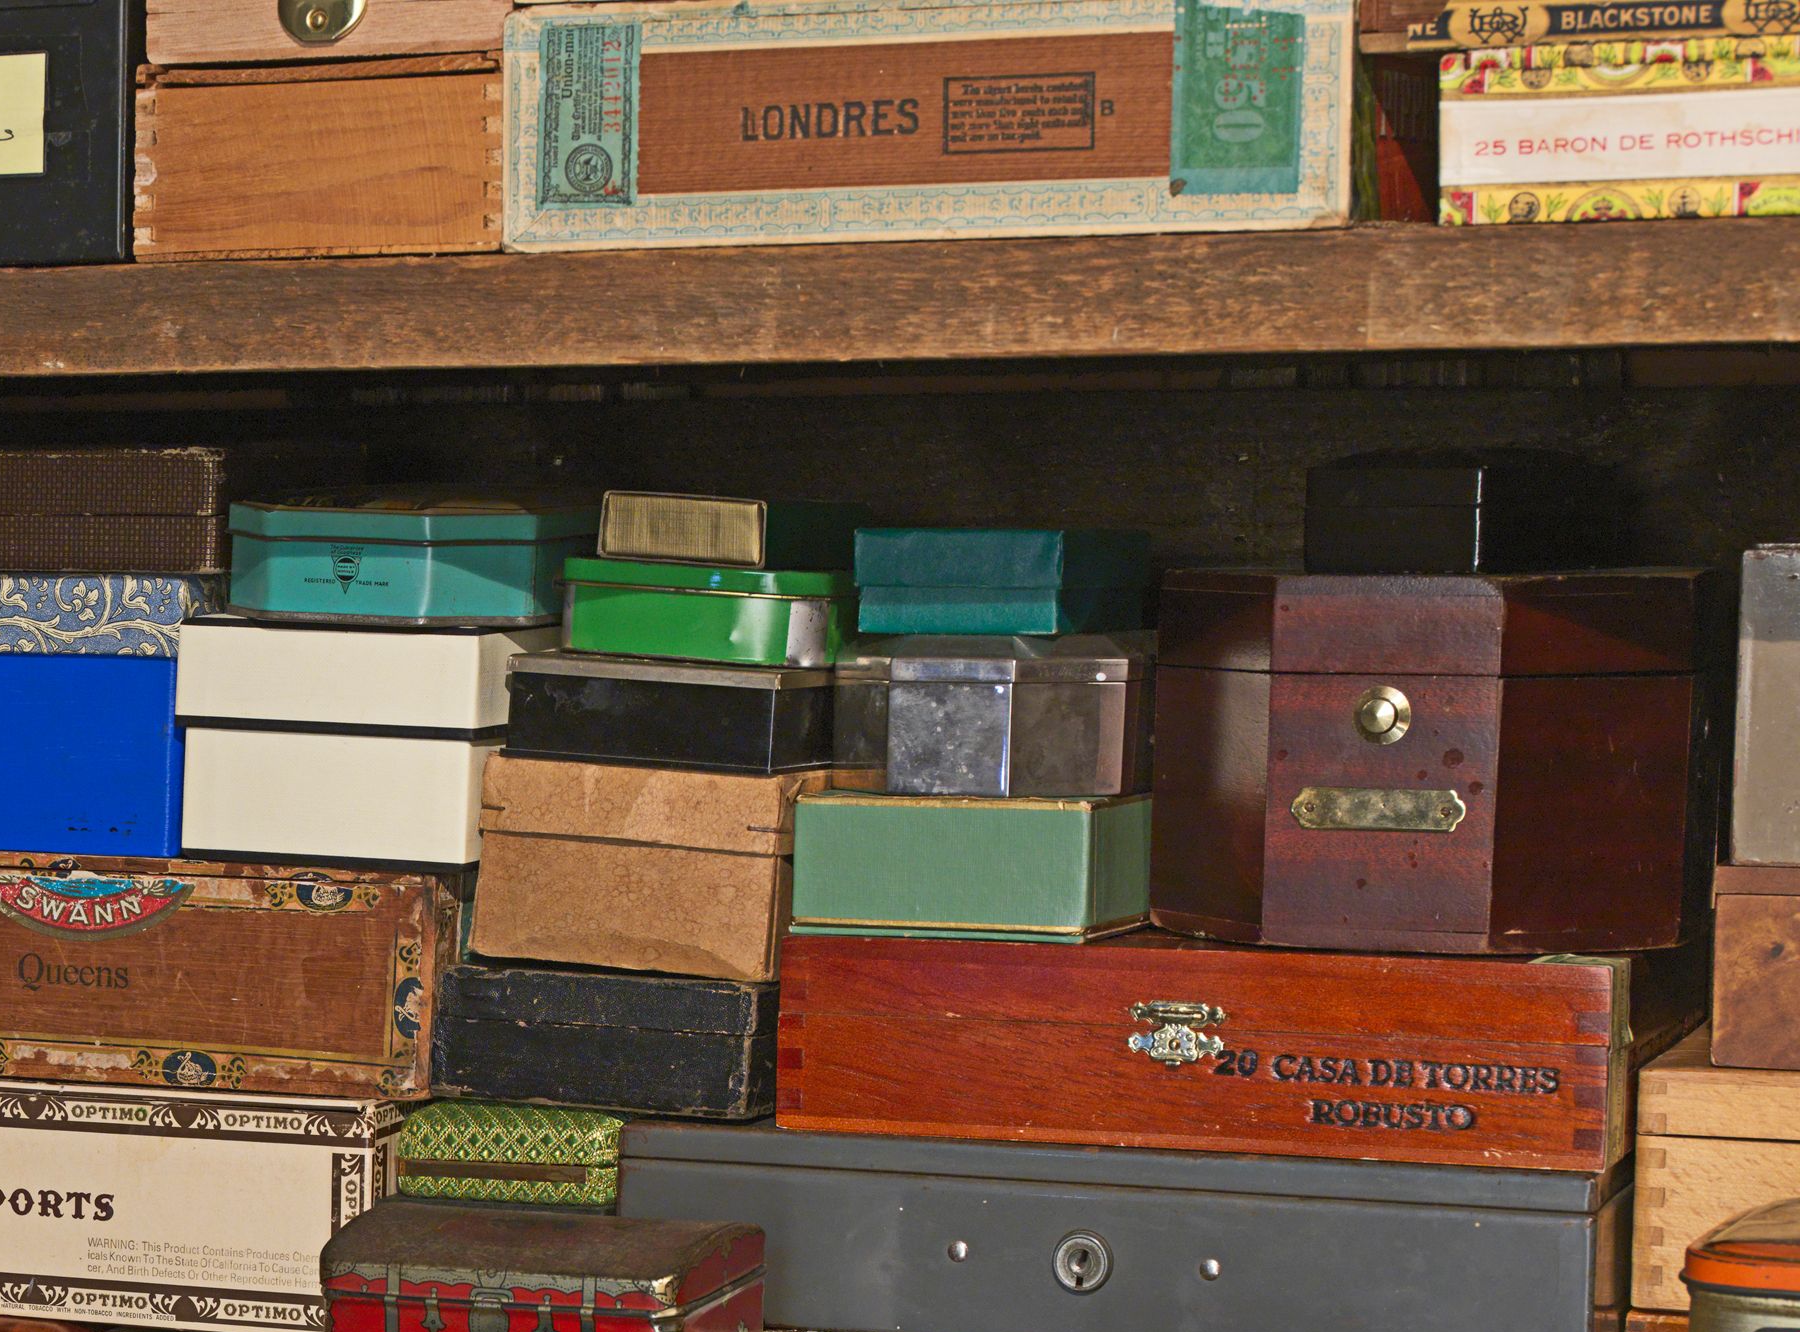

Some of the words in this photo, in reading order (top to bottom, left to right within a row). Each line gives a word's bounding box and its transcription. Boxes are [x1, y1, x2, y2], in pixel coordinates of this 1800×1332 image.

[1559, 3, 1714, 31] BLACKSTONE
[741, 98, 921, 142] LONDRES
[1101, 99, 1114, 116] B
[1474, 139, 1507, 157] 25
[1518, 136, 1608, 156] BARON
[1620, 133, 1655, 152] DE
[14, 884, 145, 926] SWANN
[17, 952, 130, 990] Queens
[1214, 1049, 1258, 1077] 20
[1272, 1053, 1361, 1086] CASA
[1369, 1059, 1416, 1088] DE
[1424, 1060, 1561, 1096] TORRES
[70, 1103, 148, 1123] OPTIMO
[223, 1112, 303, 1132] OPTIMO
[1311, 1100, 1476, 1131] ROBUSTO
[88, 1237, 139, 1251] WARNING:
[142, 1240, 160, 1252] This
[164, 1242, 200, 1256] Product
[87, 1250, 108, 1262] icals
[109, 1253, 141, 1264] Known
[143, 1255, 155, 1265] To
[156, 1255, 173, 1266] The
[175, 1257, 199, 1268] State
[200, 1258, 212, 1268] Of
[212, 1259, 257, 1272] California
[259, 1262, 271, 1273] To
[272, 1263, 301, 1275] Cause
[106, 1264, 126, 1275] And
[128, 1265, 149, 1277] Birth
[151, 1267, 186, 1280] Defects
[187, 1269, 199, 1279] Or
[201, 1270, 228, 1282] Other
[230, 1272, 294, 1288] Reproductive
[0, 1301, 26, 1310] NATURAL
[28, 1304, 54, 1312] TOBACCO
[56, 1306, 72, 1314] WITH
[74, 1308, 113, 1317] NON-TOBACCO
[115, 1311, 153, 1321] INGREDIENTS
[155, 1314, 175, 1322] ADDED
[71, 1292, 148, 1310] OPTIMO
[222, 1303, 303, 1322] OPTIMO
